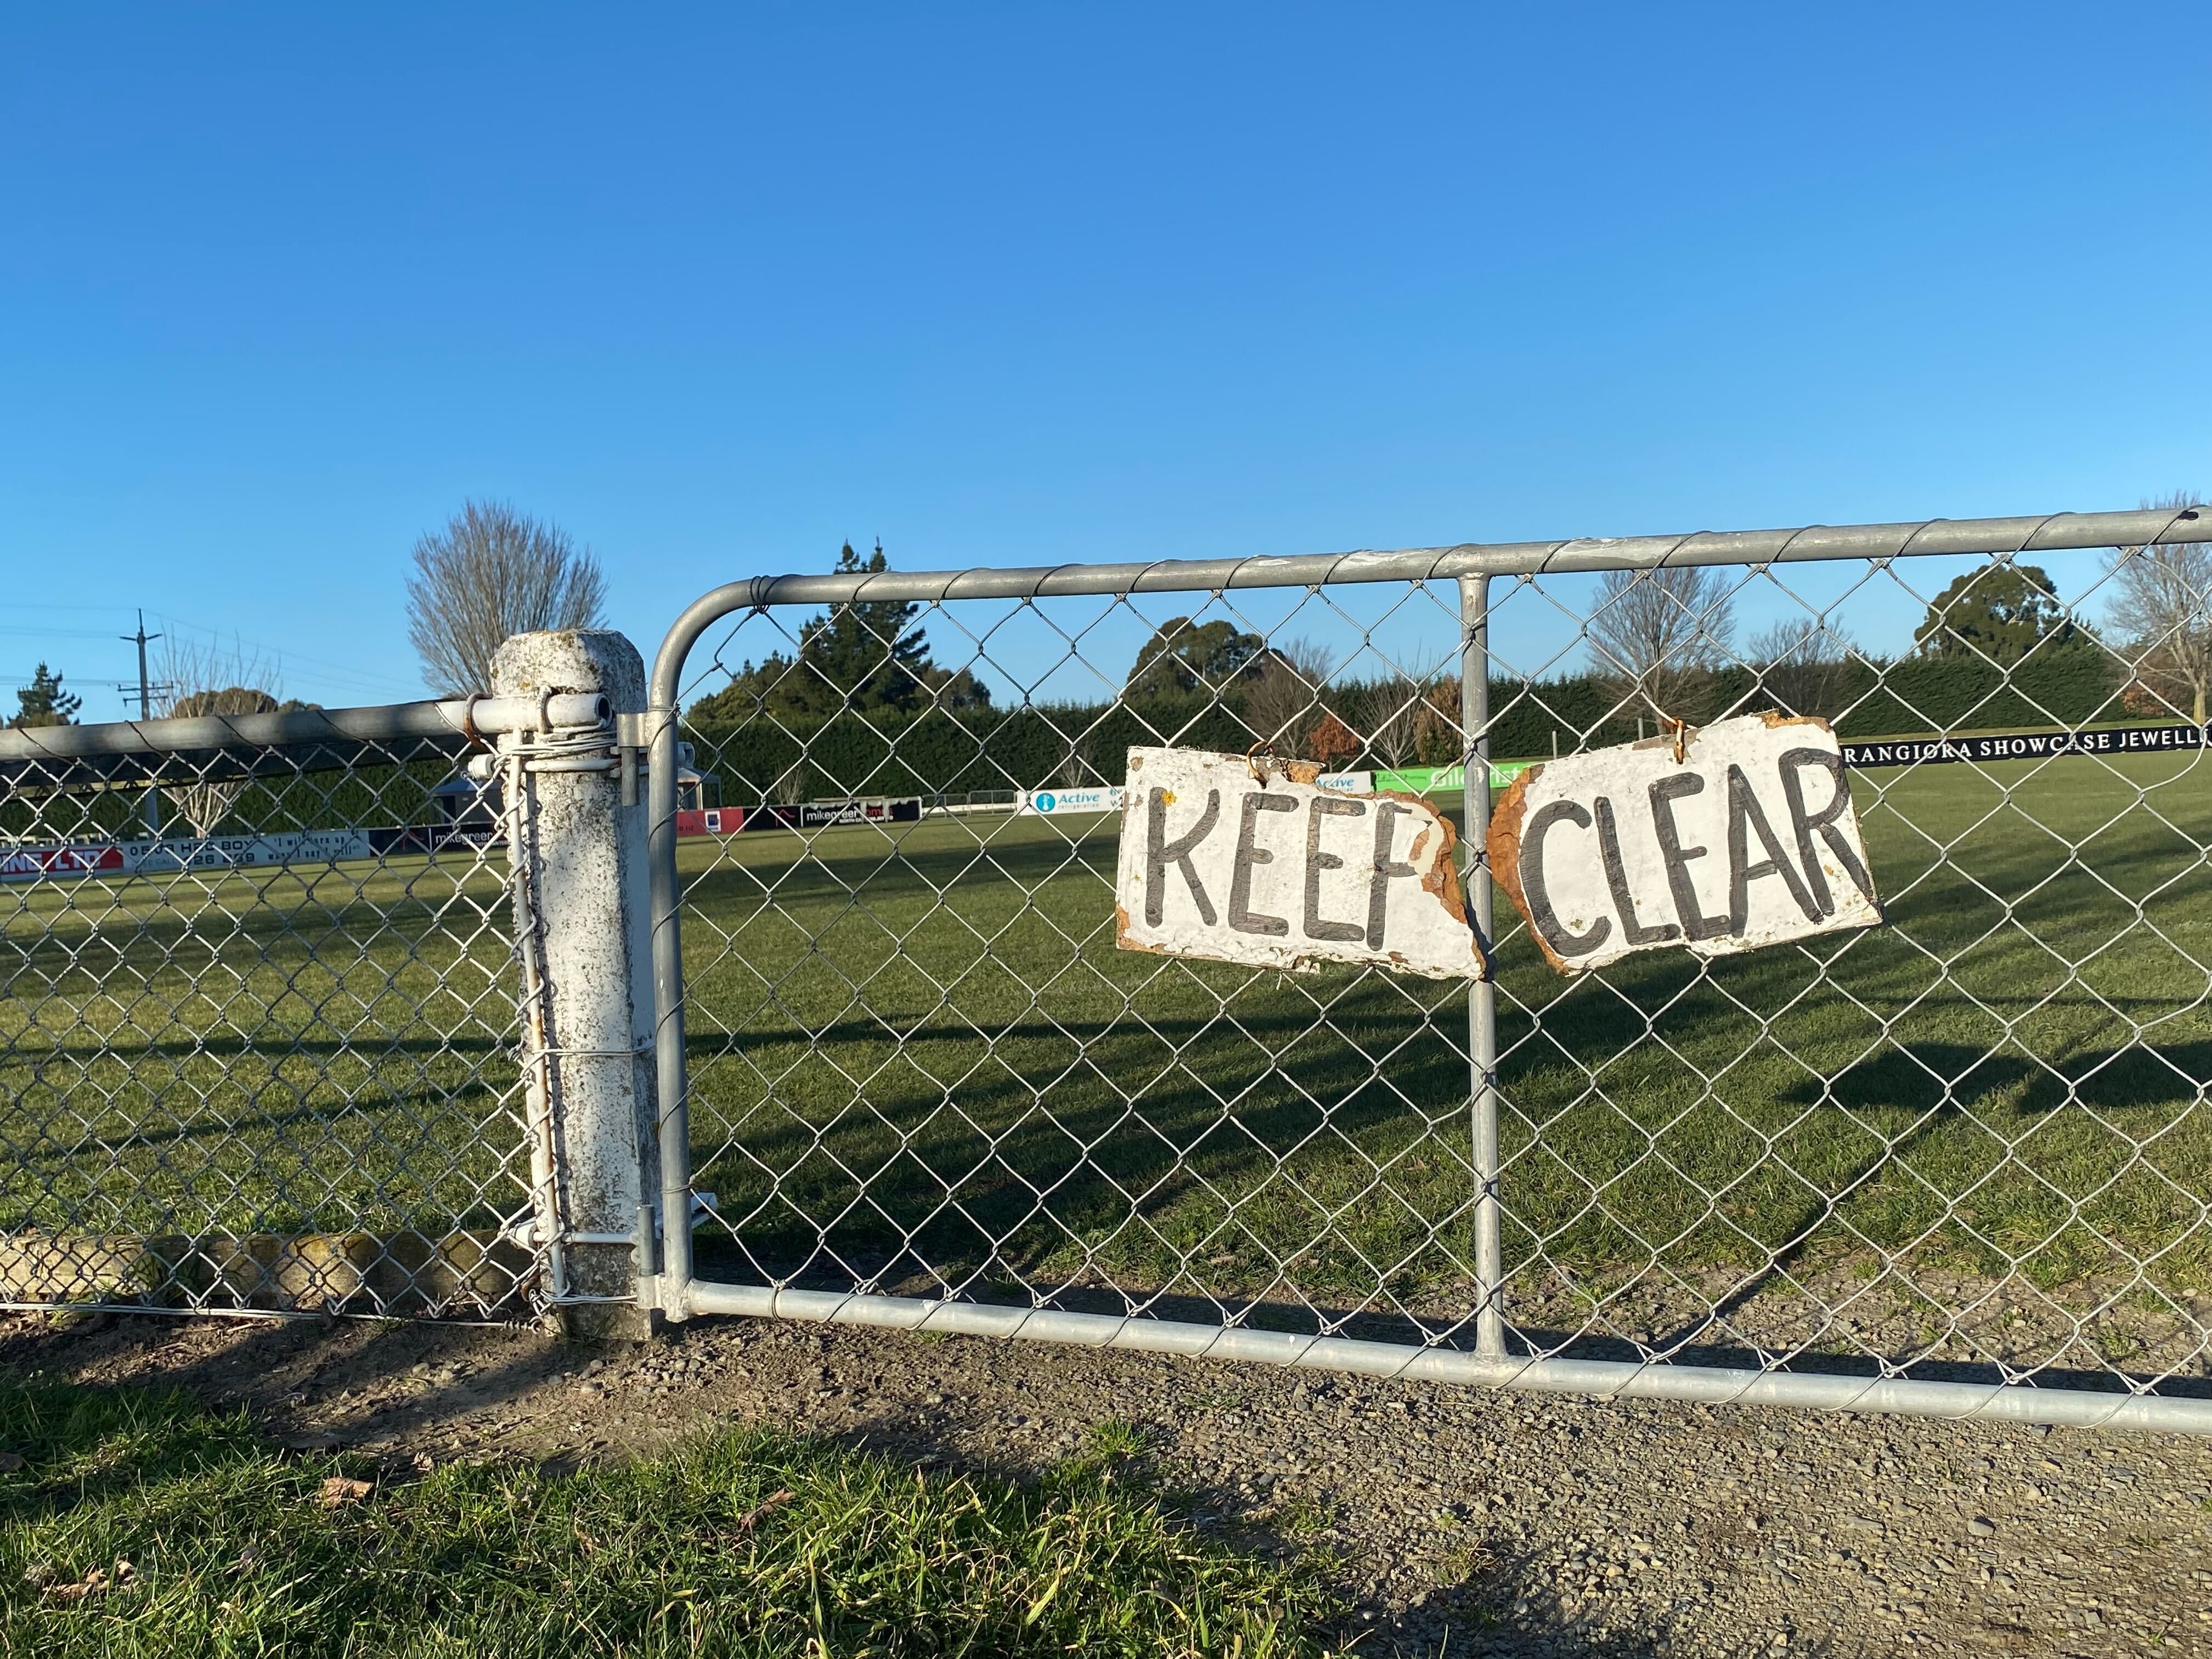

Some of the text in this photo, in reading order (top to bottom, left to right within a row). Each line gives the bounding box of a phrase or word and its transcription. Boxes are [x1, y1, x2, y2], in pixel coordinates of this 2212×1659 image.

[1844, 743, 1972, 763] RANGIORA
[1431, 767, 1521, 787] Gilrist
[1059, 792, 1099, 804] Active
[222, 840, 253, 850] BOY
[1519, 747, 1874, 957] CLEAR
[0, 850, 101, 873] ING LTD
[183, 854, 215, 866] 26
[1146, 787, 1433, 951] KEEP
